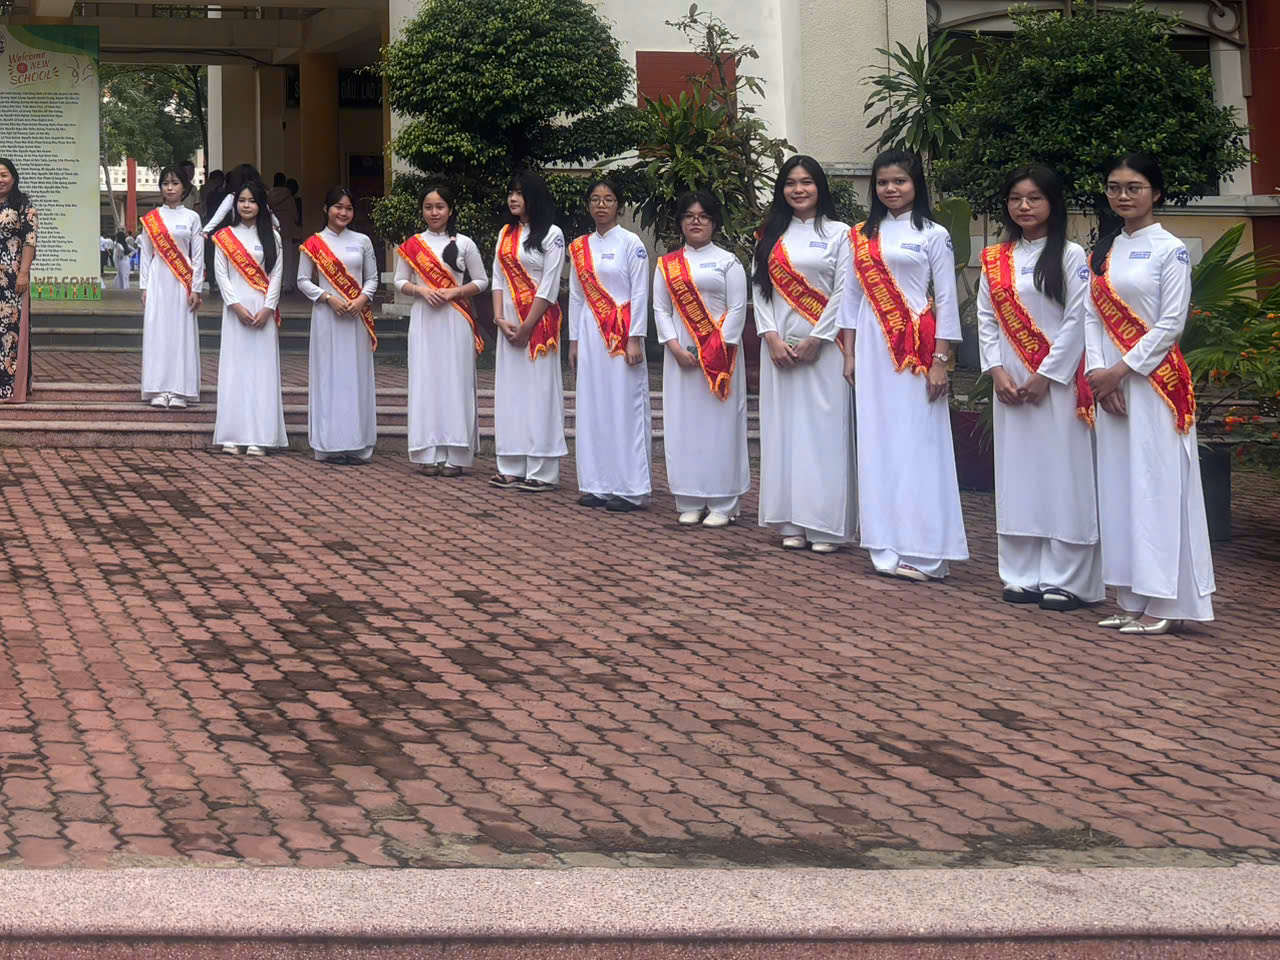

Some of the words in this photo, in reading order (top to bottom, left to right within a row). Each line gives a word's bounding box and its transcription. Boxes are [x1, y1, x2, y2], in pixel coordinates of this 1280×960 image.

[8, 51, 46, 64] Welcome
[30, 60, 50, 70] NEW
[10, 70, 52, 86] SCHOOL
[157, 233, 170, 249] THPT
[232, 250, 248, 267] THPT
[857, 242, 874, 267] THPT
[34, 276, 98, 286] WELCOME
[334, 272, 352, 290] THPT
[865, 268, 884, 284] VÕ
[770, 260, 793, 284] THPT
[799, 294, 824, 316] MINH
[671, 276, 688, 295] THPT
[686, 302, 704, 322] MINH
[872, 284, 896, 312] MINH
[886, 310, 907, 333] ĐỨC
[1001, 301, 1023, 331] MINH
[1016, 330, 1039, 353] ĐỨC
[1097, 294, 1123, 323] THPT
[1119, 320, 1140, 340] VÕ
[1156, 363, 1180, 391] ĐỨC
